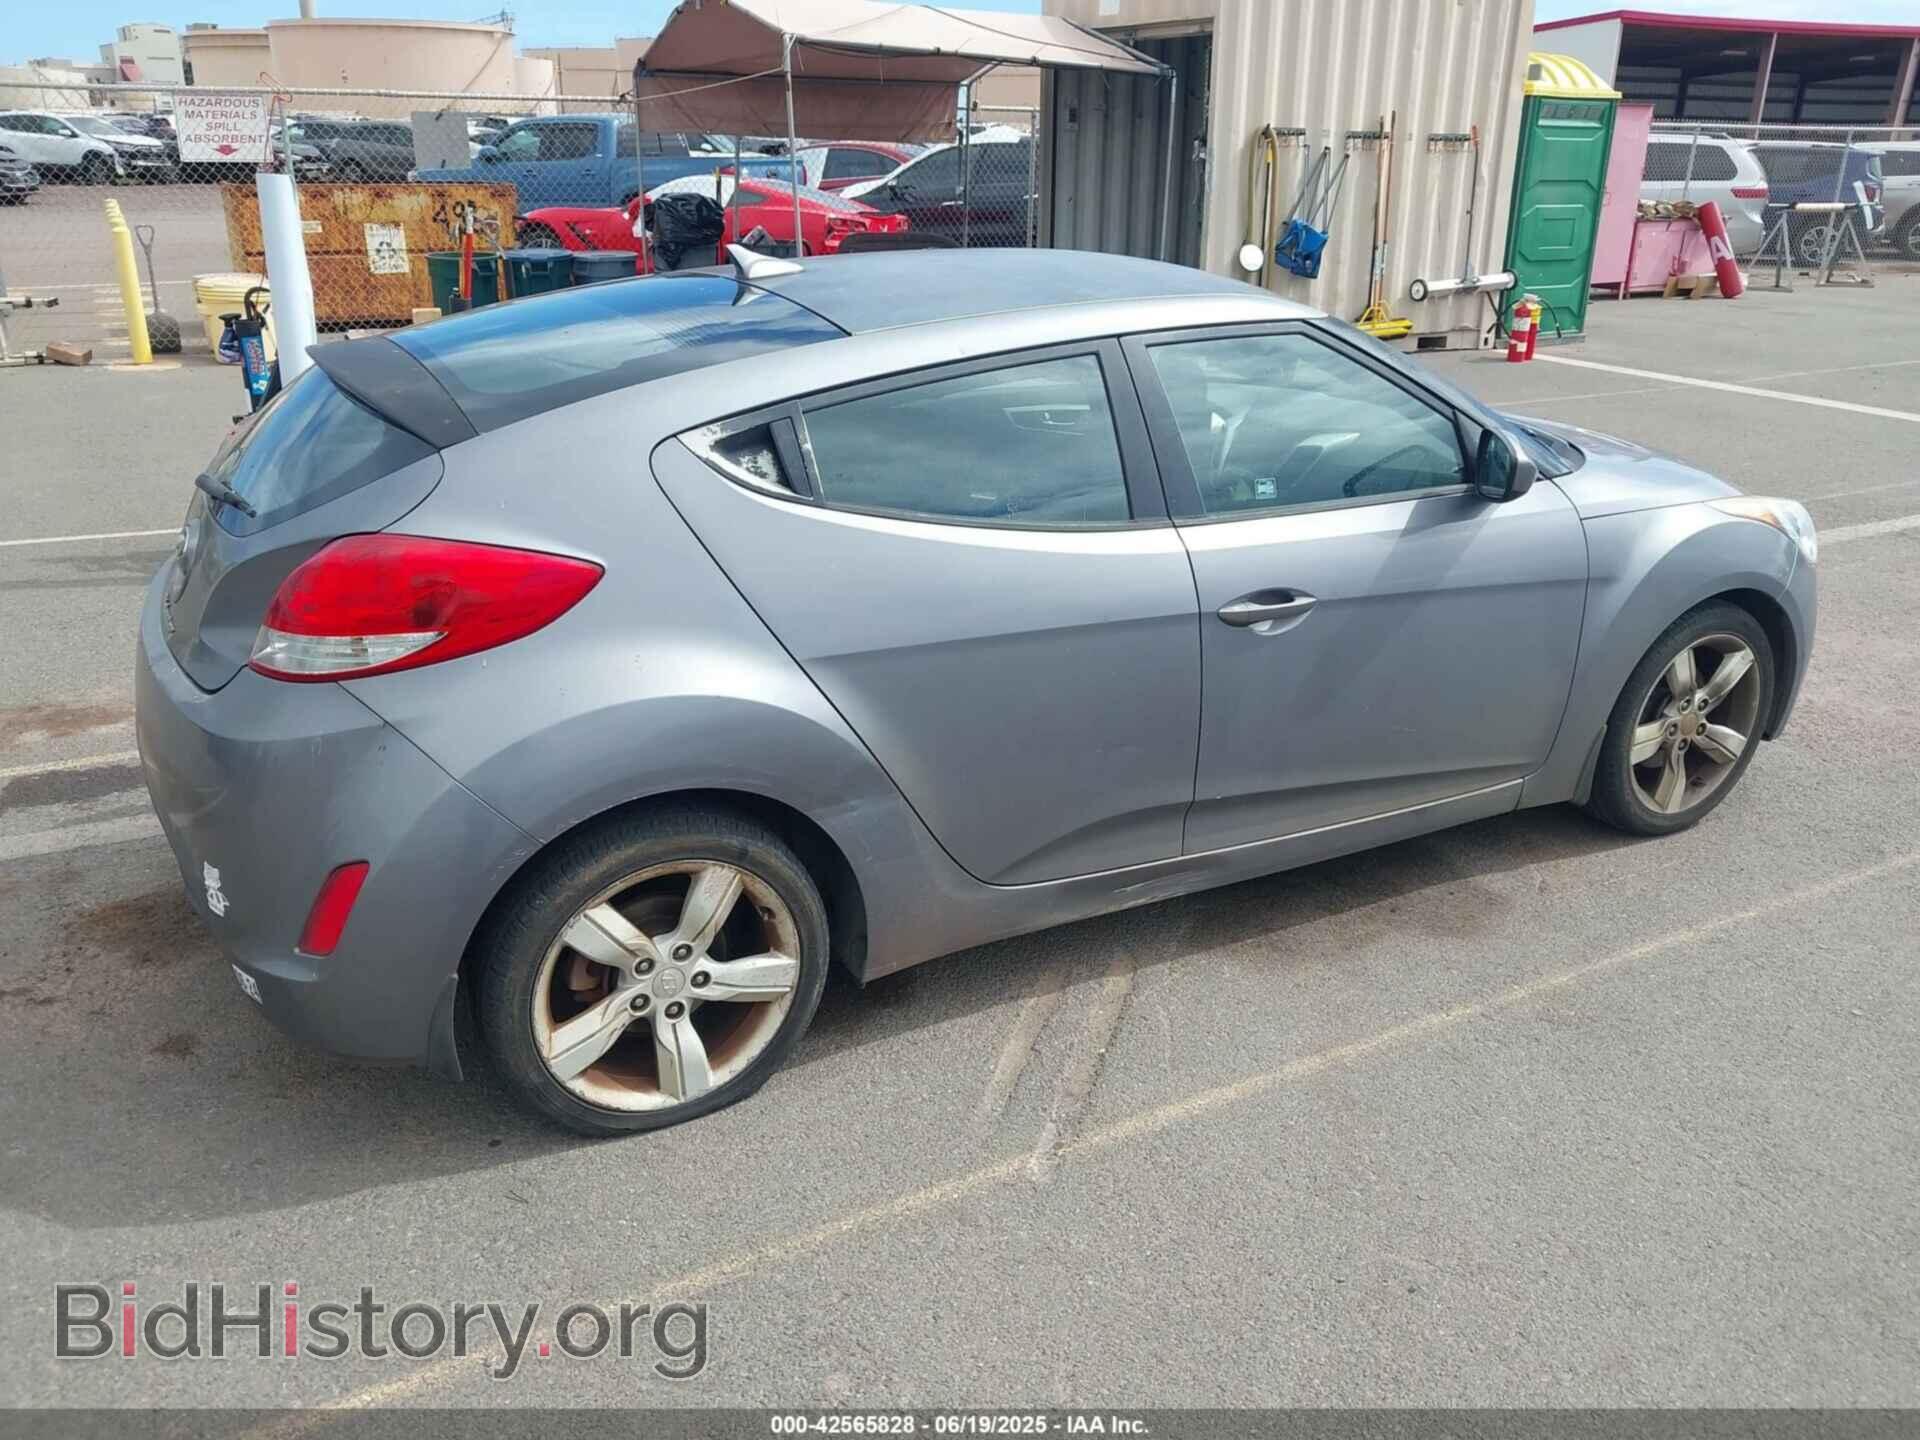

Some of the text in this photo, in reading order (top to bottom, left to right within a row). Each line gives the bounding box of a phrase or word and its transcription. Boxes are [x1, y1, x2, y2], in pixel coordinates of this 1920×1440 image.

[178, 97, 260, 108] HAZARDOUS
[184, 110, 257, 120] MATERIALS
[205, 121, 240, 131] SPILL
[183, 133, 264, 144] ABSORBENT
